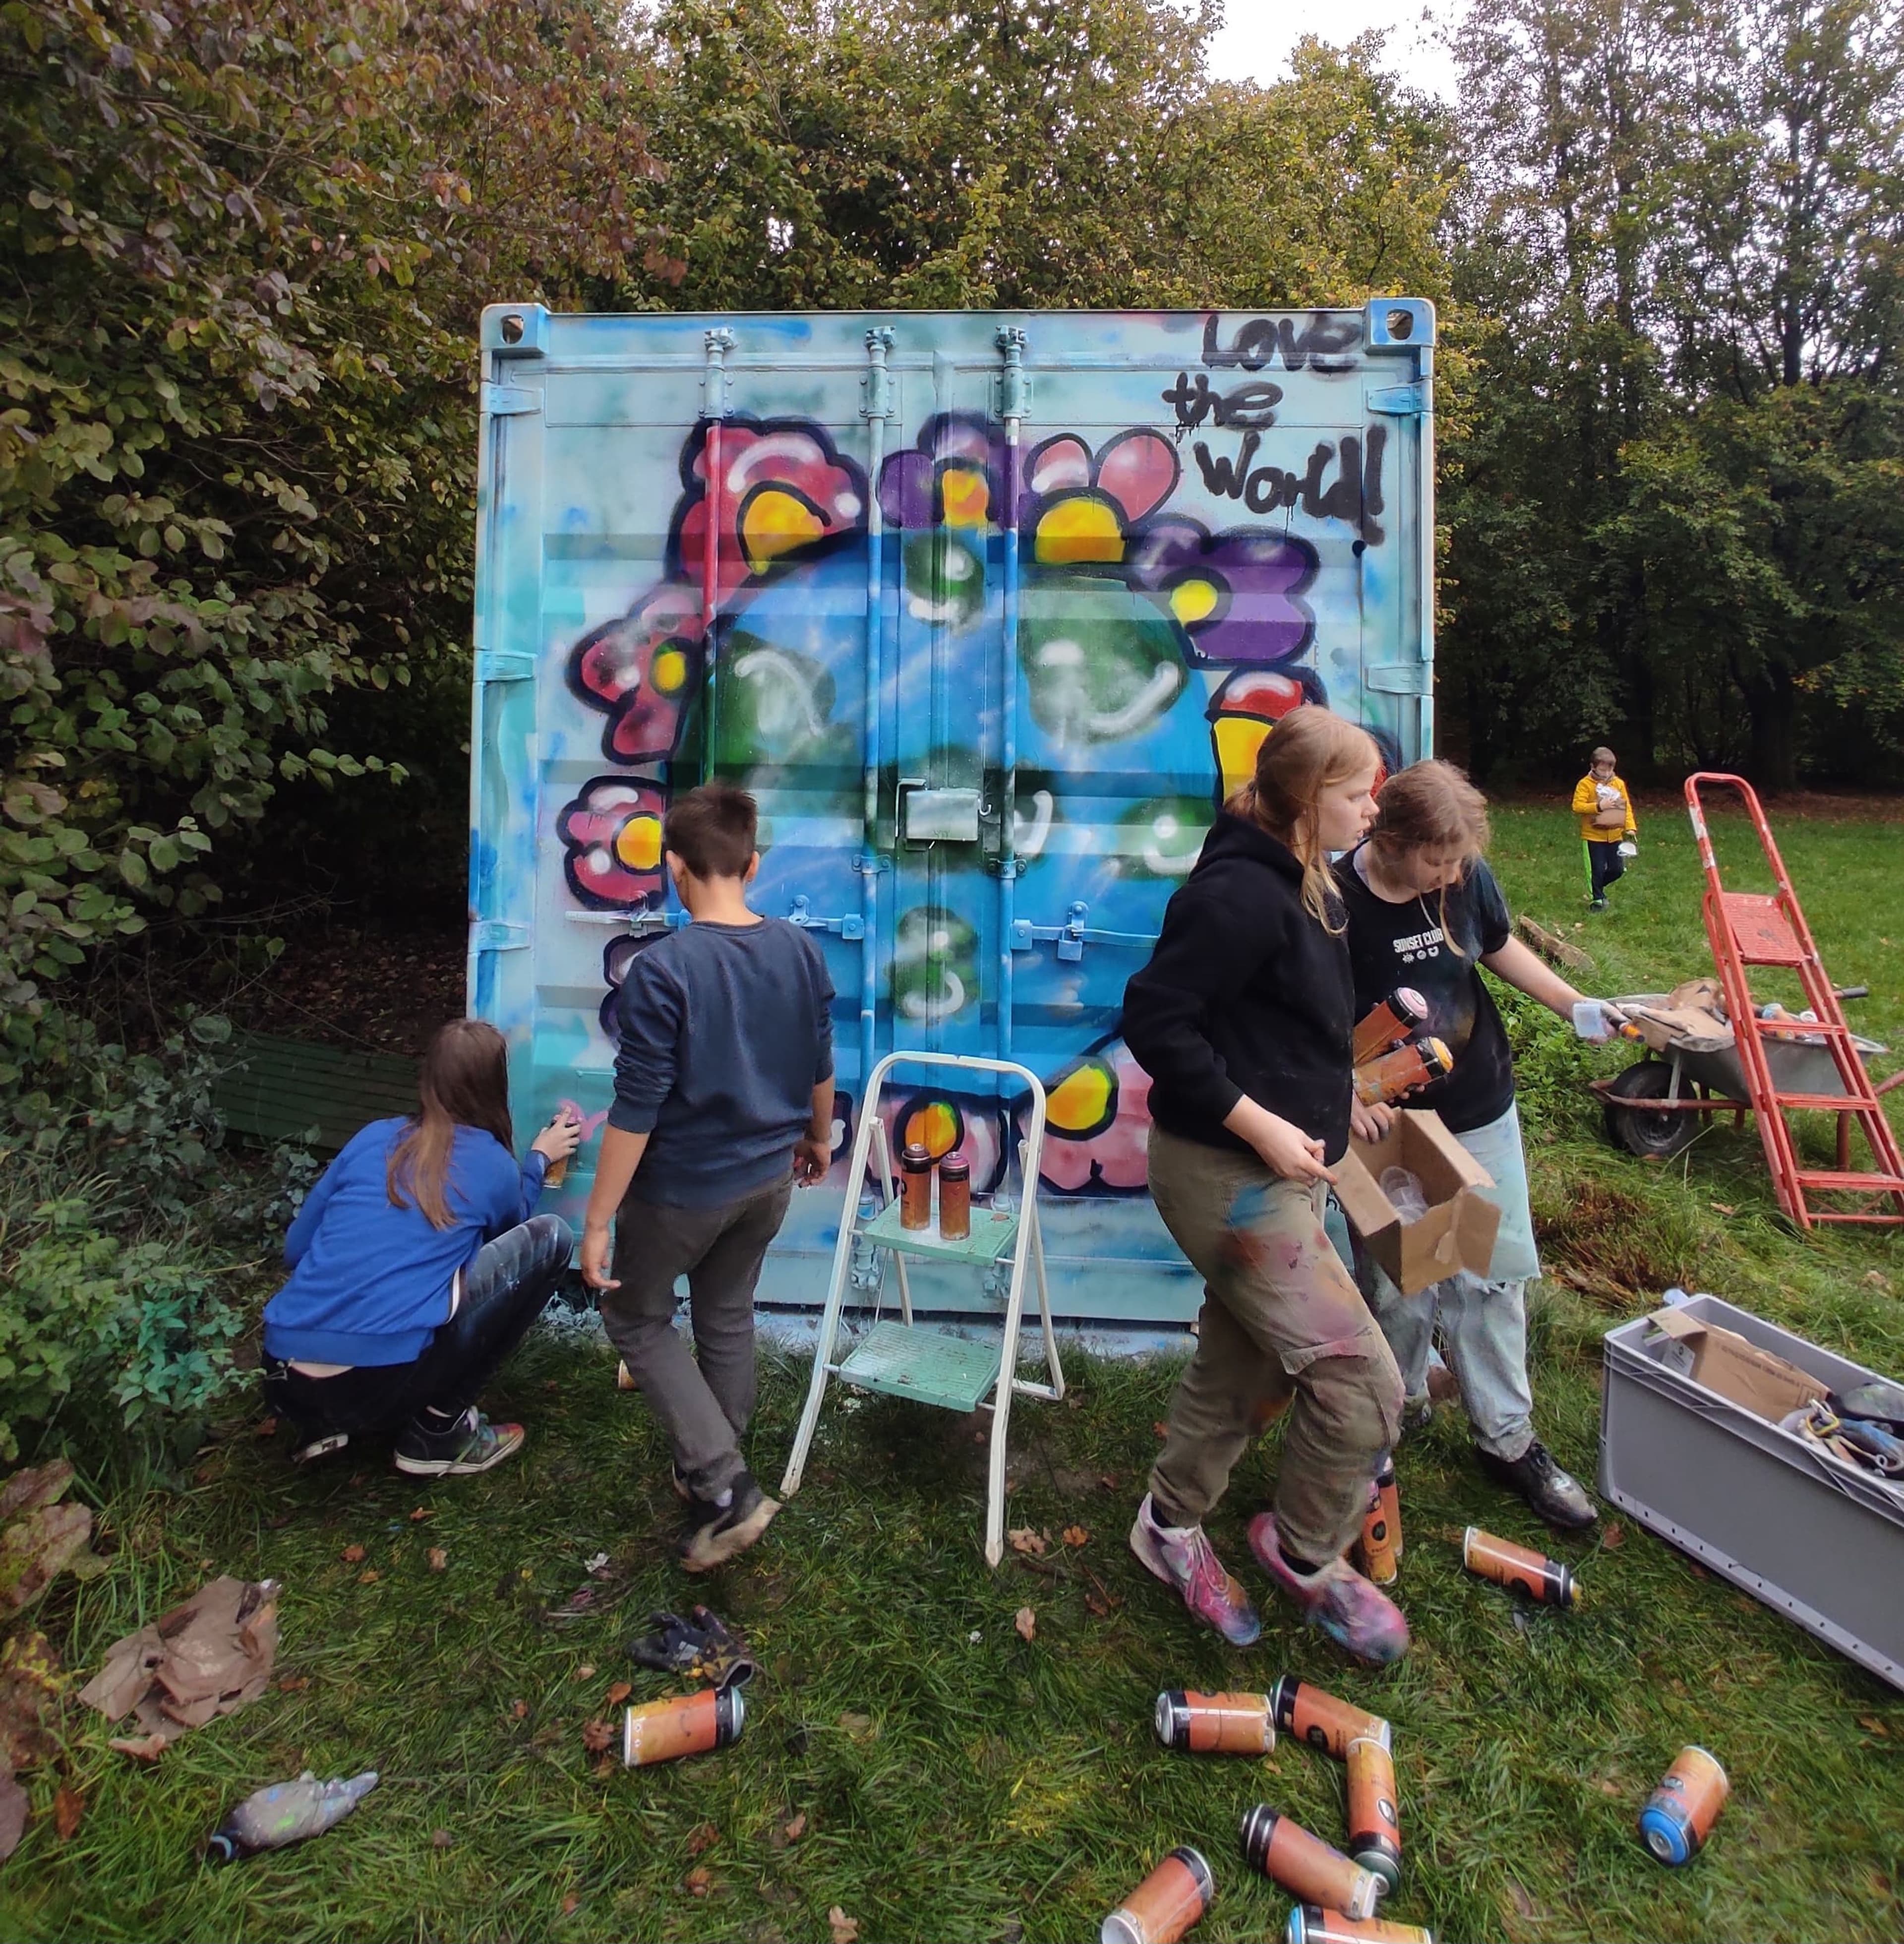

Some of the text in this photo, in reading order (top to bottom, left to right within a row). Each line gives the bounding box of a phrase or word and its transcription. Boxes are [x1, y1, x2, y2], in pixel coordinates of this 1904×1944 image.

[1162, 372, 1283, 428] the
[1393, 928, 1444, 953] SUNSET CLUB
